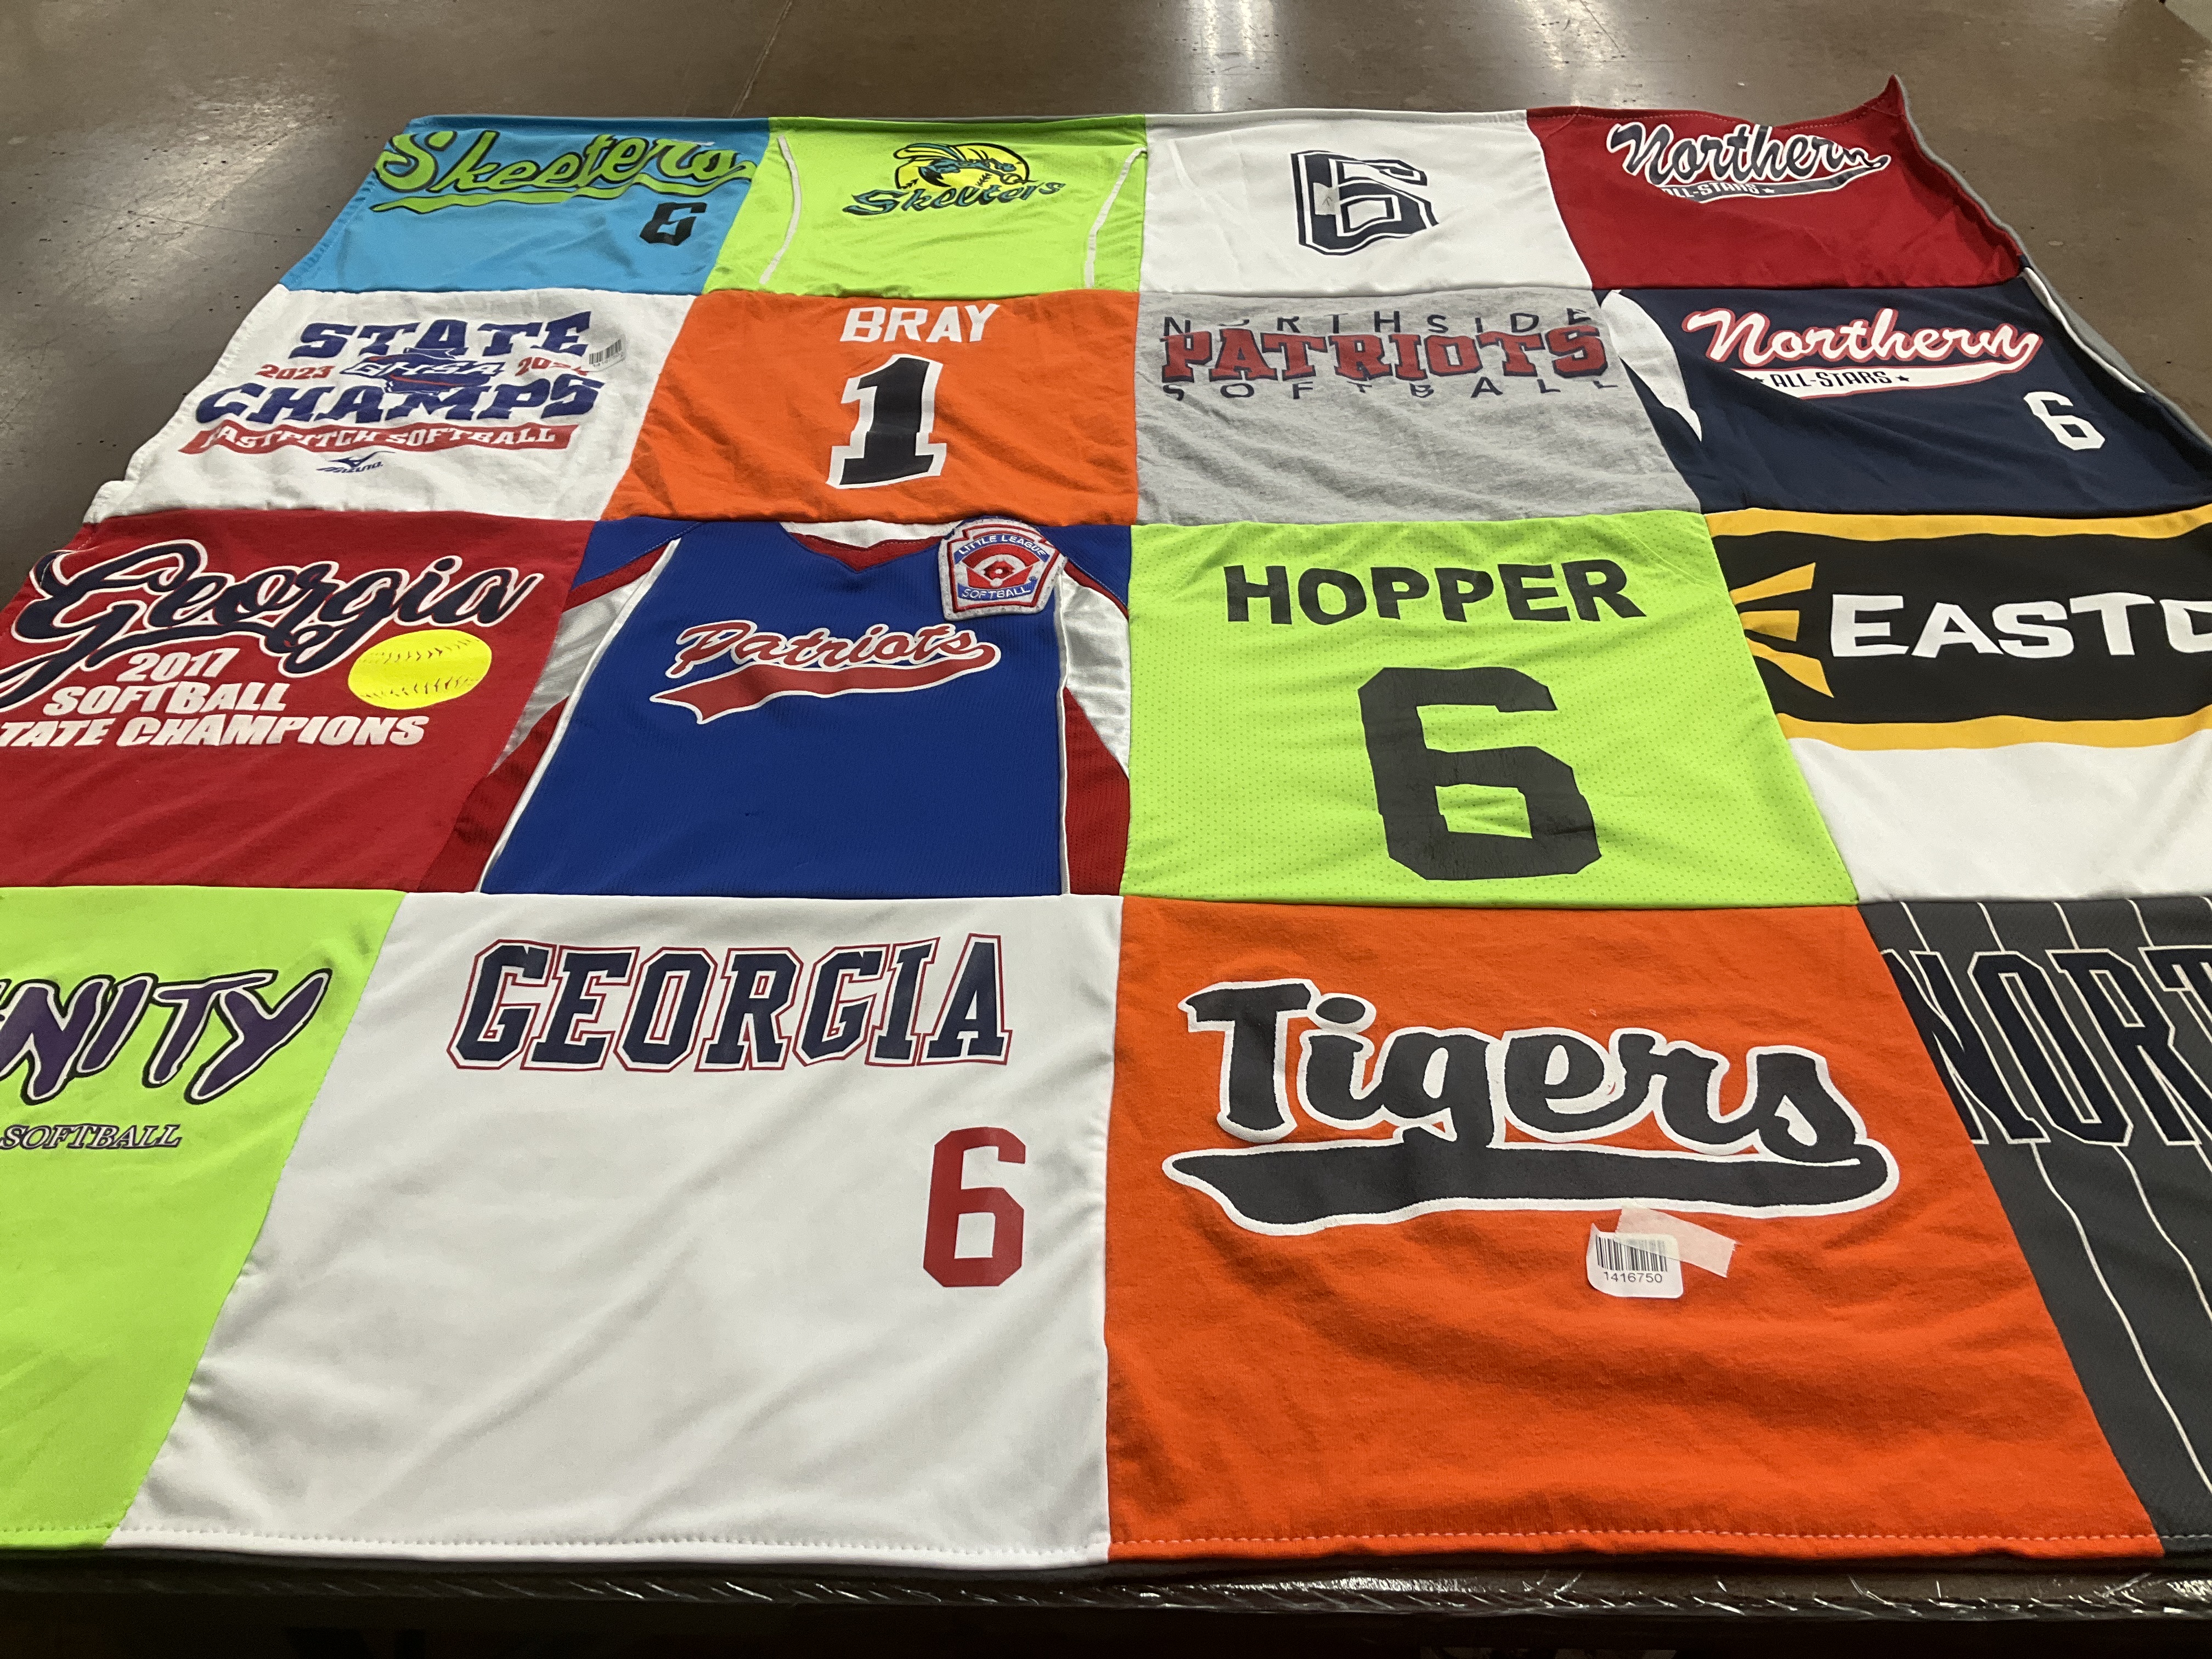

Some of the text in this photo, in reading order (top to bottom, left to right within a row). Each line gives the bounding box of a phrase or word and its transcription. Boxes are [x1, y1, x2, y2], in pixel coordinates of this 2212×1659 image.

[374, 130, 755, 196] Skeeters
[1606, 122, 1892, 185] Northern
[842, 182, 1066, 216] Skeeters
[1290, 150, 1438, 255] 6
[289, 311, 592, 359] STATE
[840, 303, 1000, 343] BRAY
[1681, 308, 2043, 369] Northern
[254, 364, 335, 380] 2023
[340, 361, 506, 379] GHSA
[1160, 324, 1608, 383] PATRIOTS
[1769, 371, 1893, 388] ALL-STARS
[195, 373, 605, 424] CHAMPS
[826, 354, 947, 489] 1
[2023, 391, 2106, 450] 6
[200, 425, 556, 449] FASTPITCH SOFTBALL
[958, 534, 1047, 556] LITTLE LEAGUE
[0, 539, 544, 697] Georgia
[962, 586, 1031, 599] SOFTBALL
[1223, 559, 1647, 625] HOPPER
[117, 648, 240, 683] 2017
[664, 619, 998, 681] Patriots
[43, 682, 291, 716] SOFTBALL
[0, 714, 430, 747] TATE CHAMPIONS
[1357, 667, 1602, 881] 6
[447, 933, 1013, 1073] GEORGIA
[0, 968, 333, 1105] NITY
[1178, 978, 1879, 1169] Tigers
[0, 1122, 182, 1150] SOFTBALL
[923, 1126, 1026, 1288] 6
[1603, 1271, 1663, 1284] 1416750
